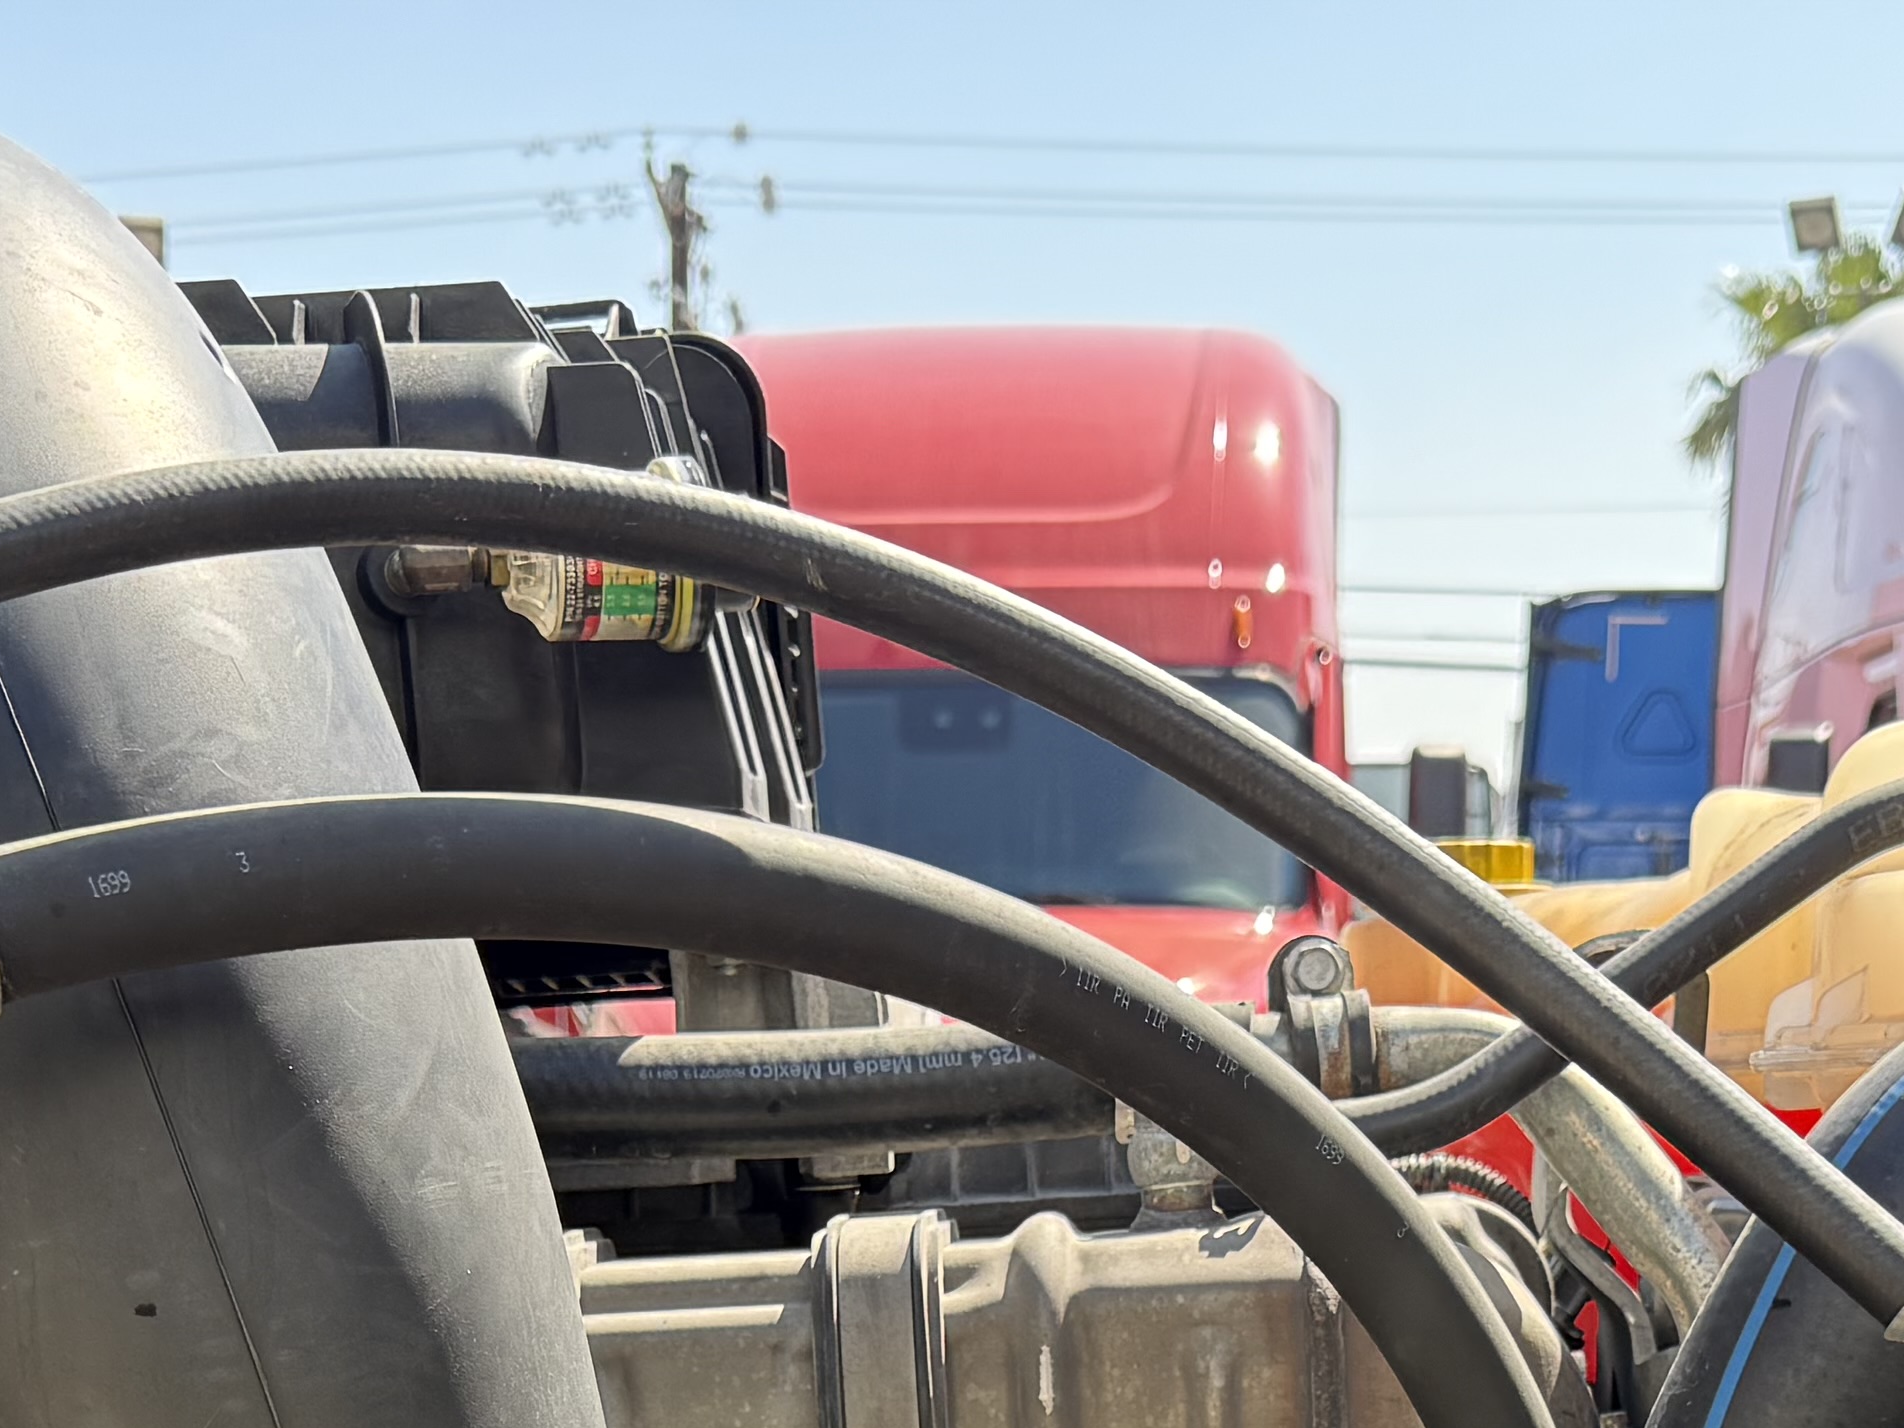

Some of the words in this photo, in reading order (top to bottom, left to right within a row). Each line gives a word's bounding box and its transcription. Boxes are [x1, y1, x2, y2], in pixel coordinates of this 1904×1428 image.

[88, 870, 132, 898] 1699
[1113, 985, 1132, 1010] PA
[1179, 1025, 1205, 1054] PET
[749, 1062, 822, 1081] Mexico
[853, 1054, 913, 1077] Made
[1315, 1134, 1344, 1165] 1699
